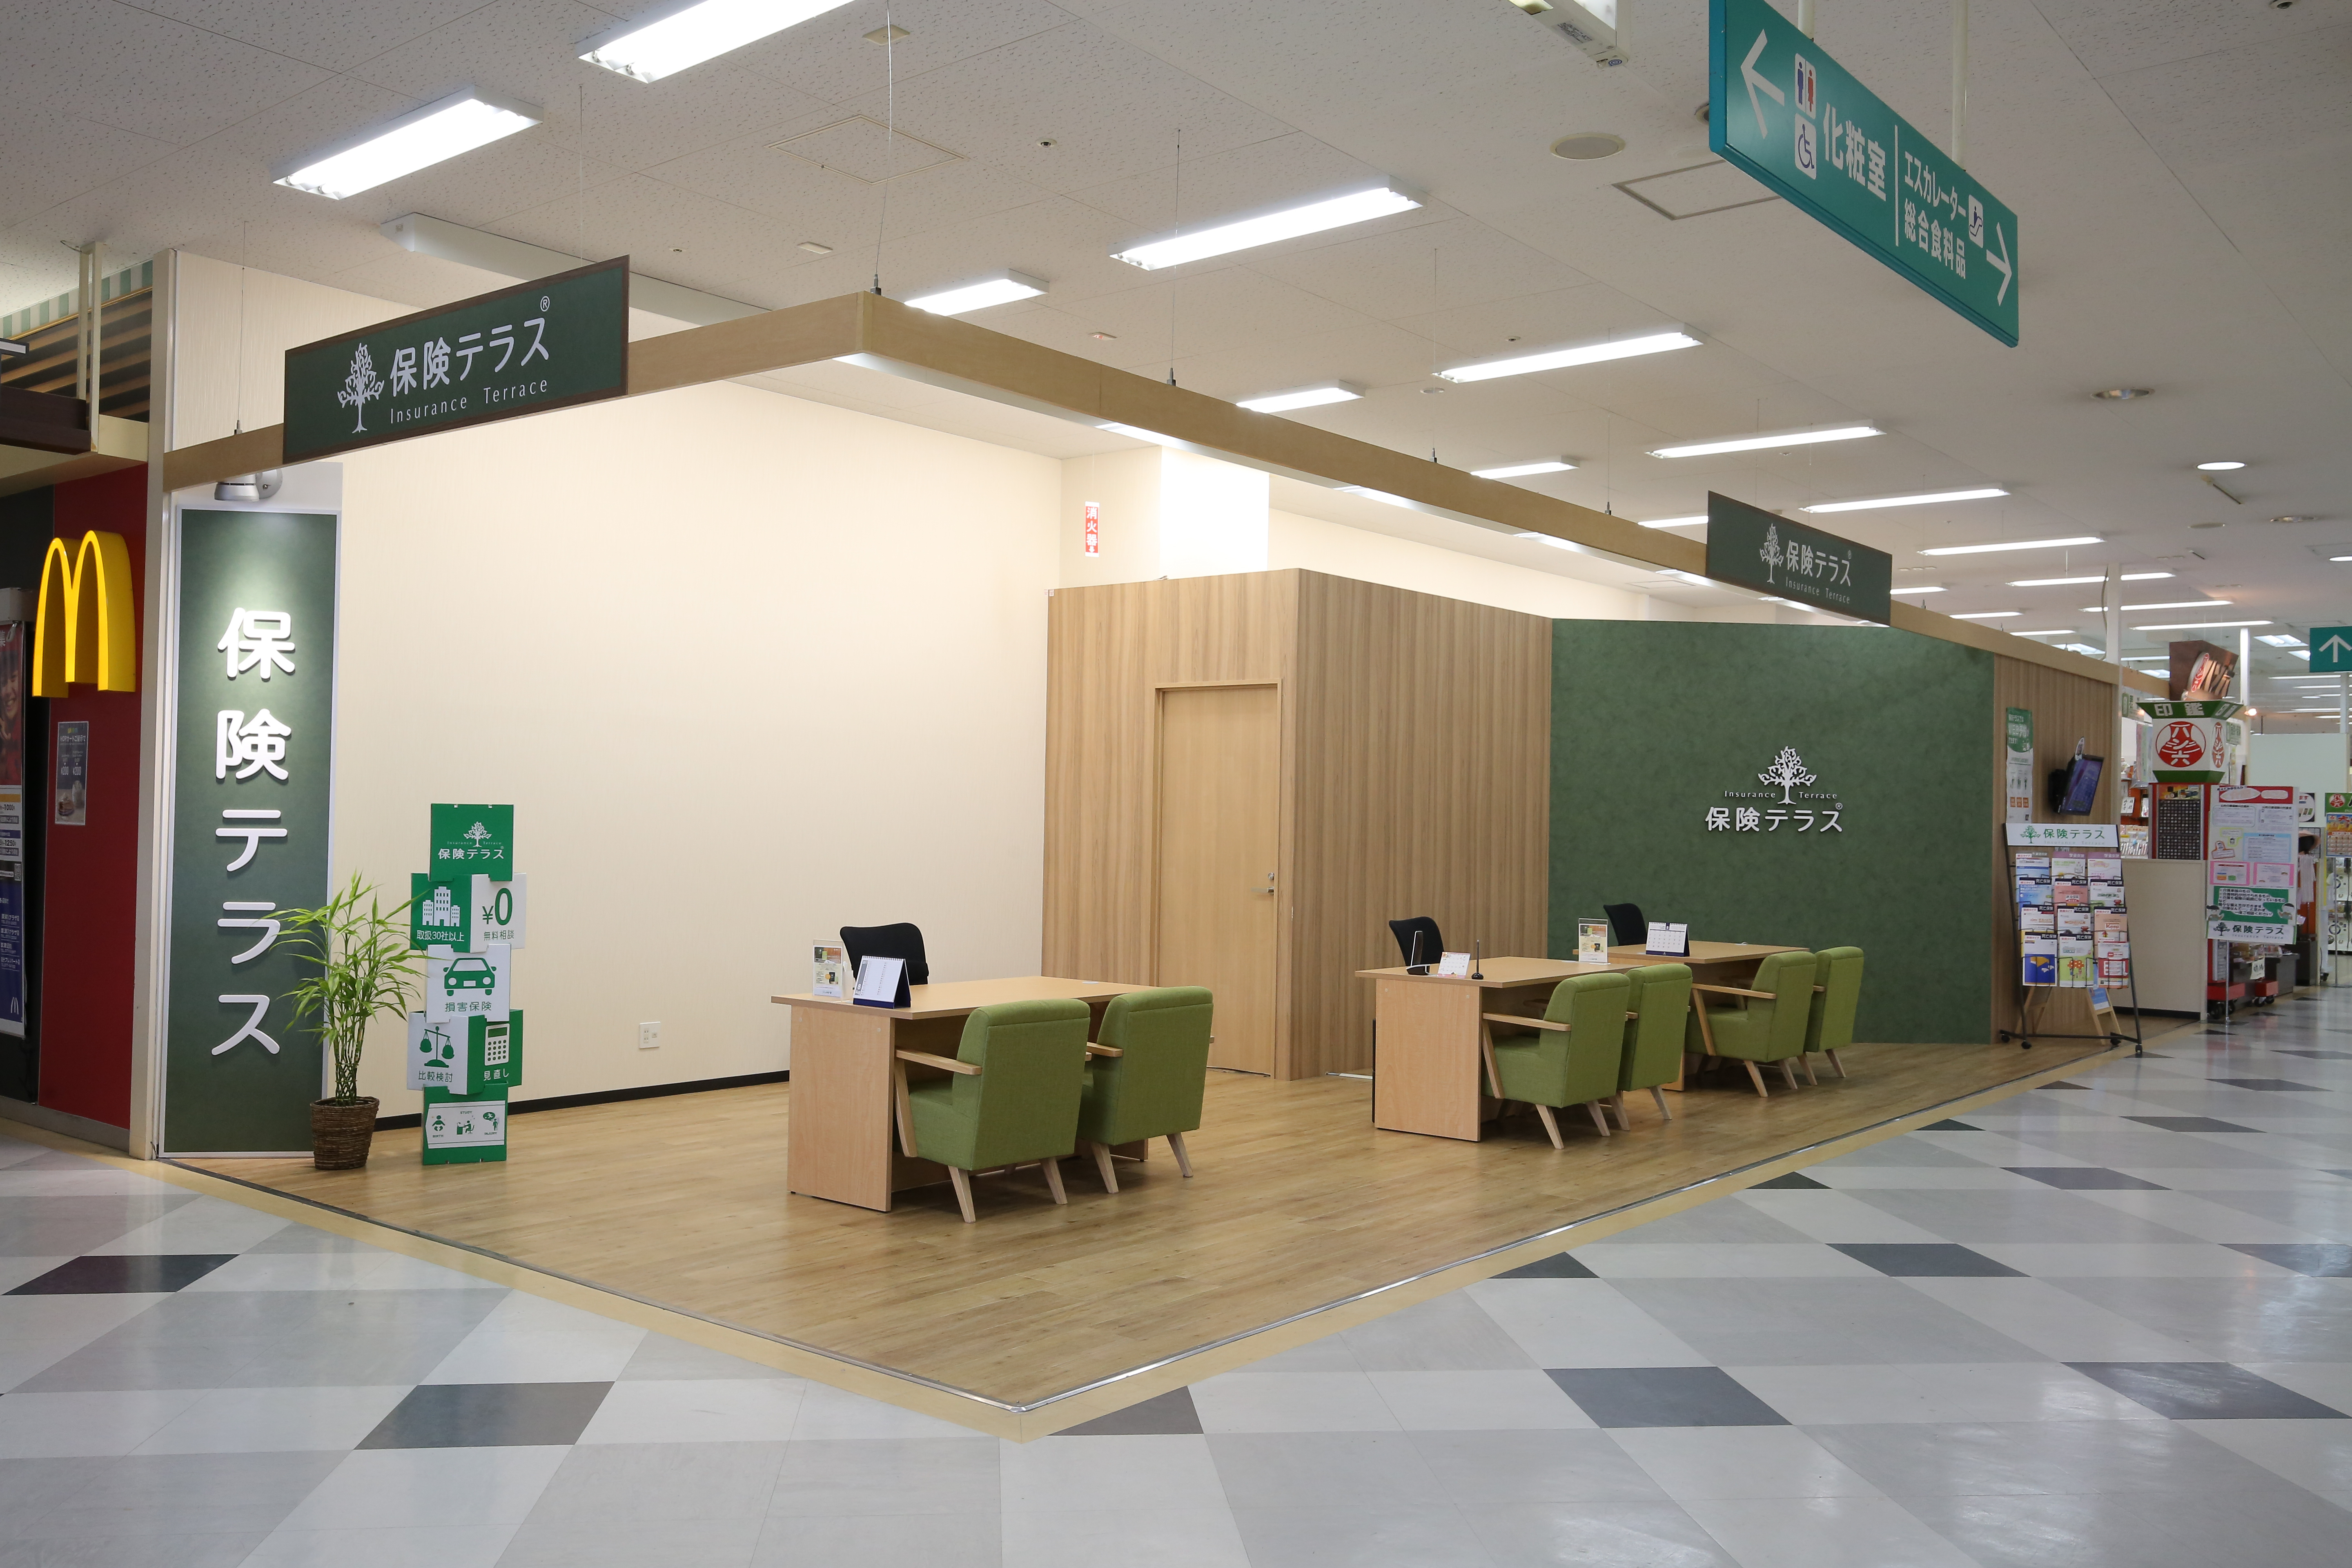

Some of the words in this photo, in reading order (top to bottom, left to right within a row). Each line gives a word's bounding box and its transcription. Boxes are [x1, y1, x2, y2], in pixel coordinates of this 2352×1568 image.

[1823, 102, 1886, 201] 化粧室
[1905, 151, 1967, 220] エスカレーター
[1904, 198, 1966, 279] 総合食料品
[390, 317, 550, 397] 保険テラス
[390, 396, 467, 424] Insurance
[483, 379, 548, 404] Terrace
[1086, 507, 1098, 546] 消火器
[1786, 540, 1851, 586] 保険テラス
[1786, 577, 1820, 596] Insurance
[1826, 588, 1850, 604] Terrace
[212, 607, 295, 1056] 保険テラス
[1705, 806, 1843, 832] 保険テラス
[2043, 829, 2105, 839] 保険テラス
[438, 848, 504, 860] 保険テラス
[482, 887, 513, 926] ¥0
[417, 930, 465, 942] 取扱30社以上
[483, 930, 514, 941] 無料相談
[2232, 925, 2284, 935] 保険テラス
[445, 1001, 492, 1012] 損害保険
[418, 1070, 453, 1083] 比較検討
[483, 1068, 510, 1081] 見直し
